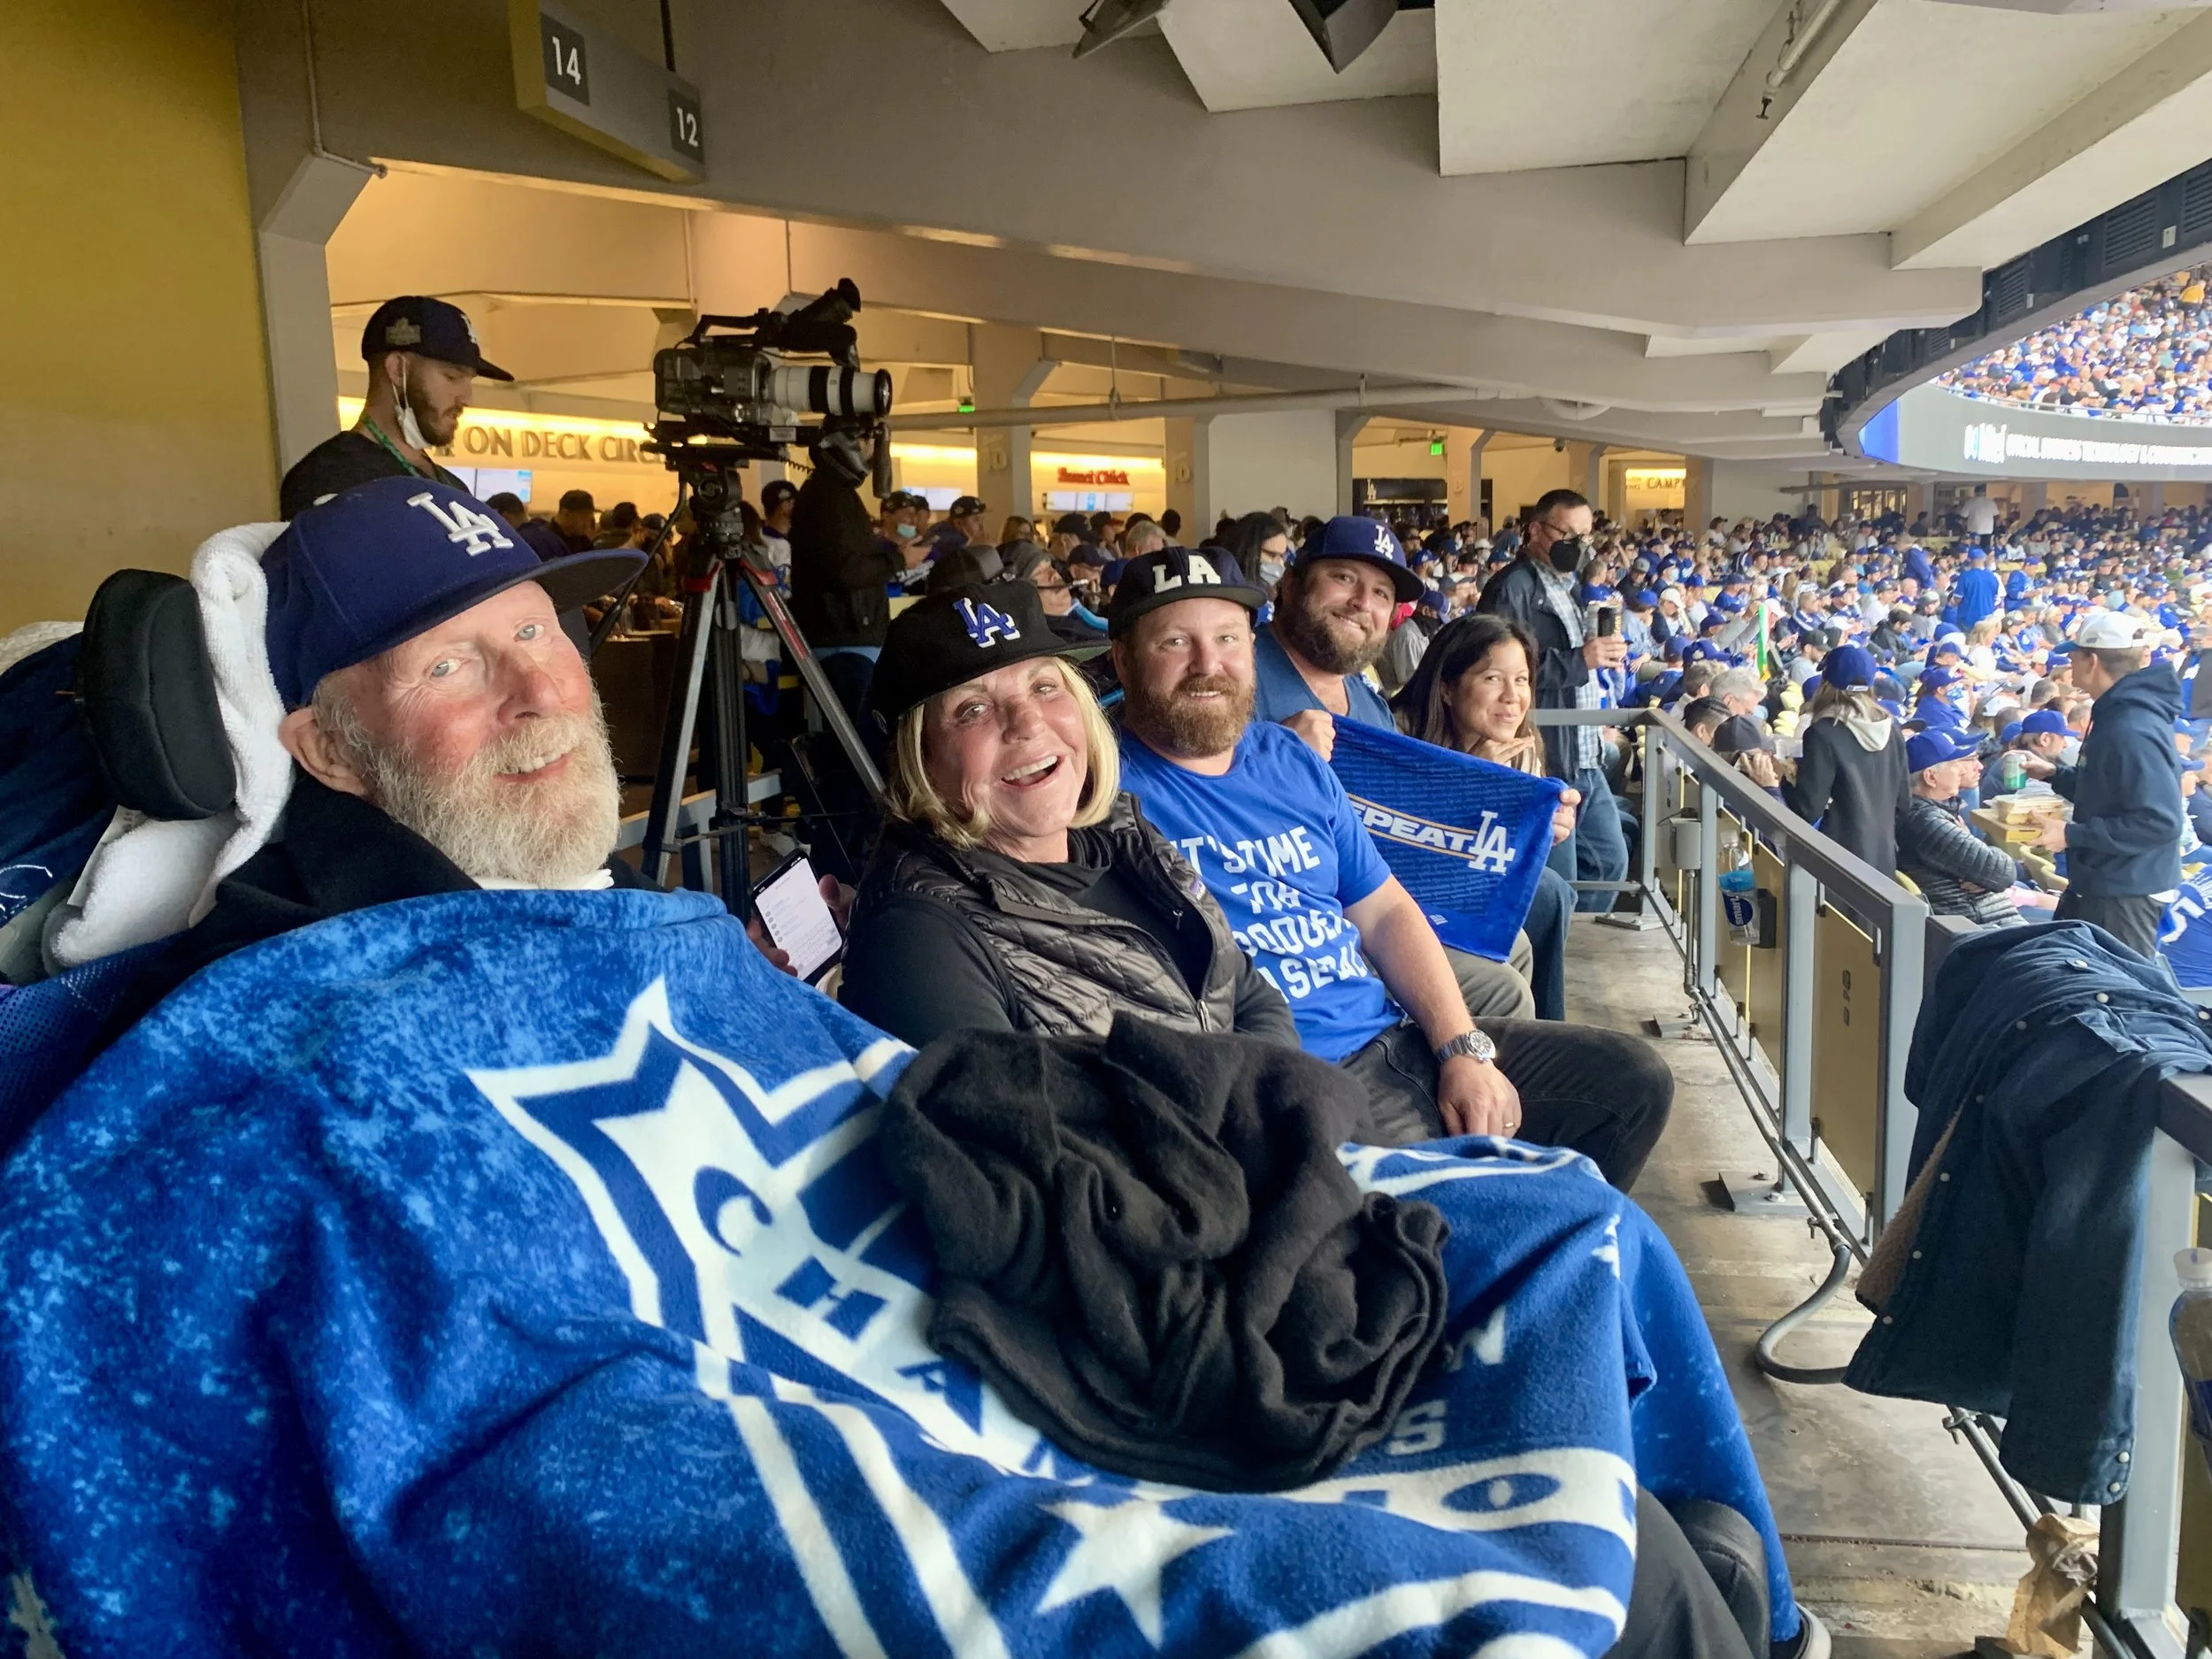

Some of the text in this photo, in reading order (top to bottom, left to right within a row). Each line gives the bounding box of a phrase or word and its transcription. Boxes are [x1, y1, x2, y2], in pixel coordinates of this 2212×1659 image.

[552, 36, 581, 85] 14
[677, 106, 698, 148] 12
[463, 426, 666, 465] ON DECK CIRC
[407, 492, 514, 557] LA
[1374, 524, 1394, 560] LA
[1152, 555, 1222, 594] LA
[953, 597, 1020, 649] LA
[1170, 835, 1247, 877] T'S
[1467, 810, 1517, 876] LA
[2161, 895, 2207, 944] 5
